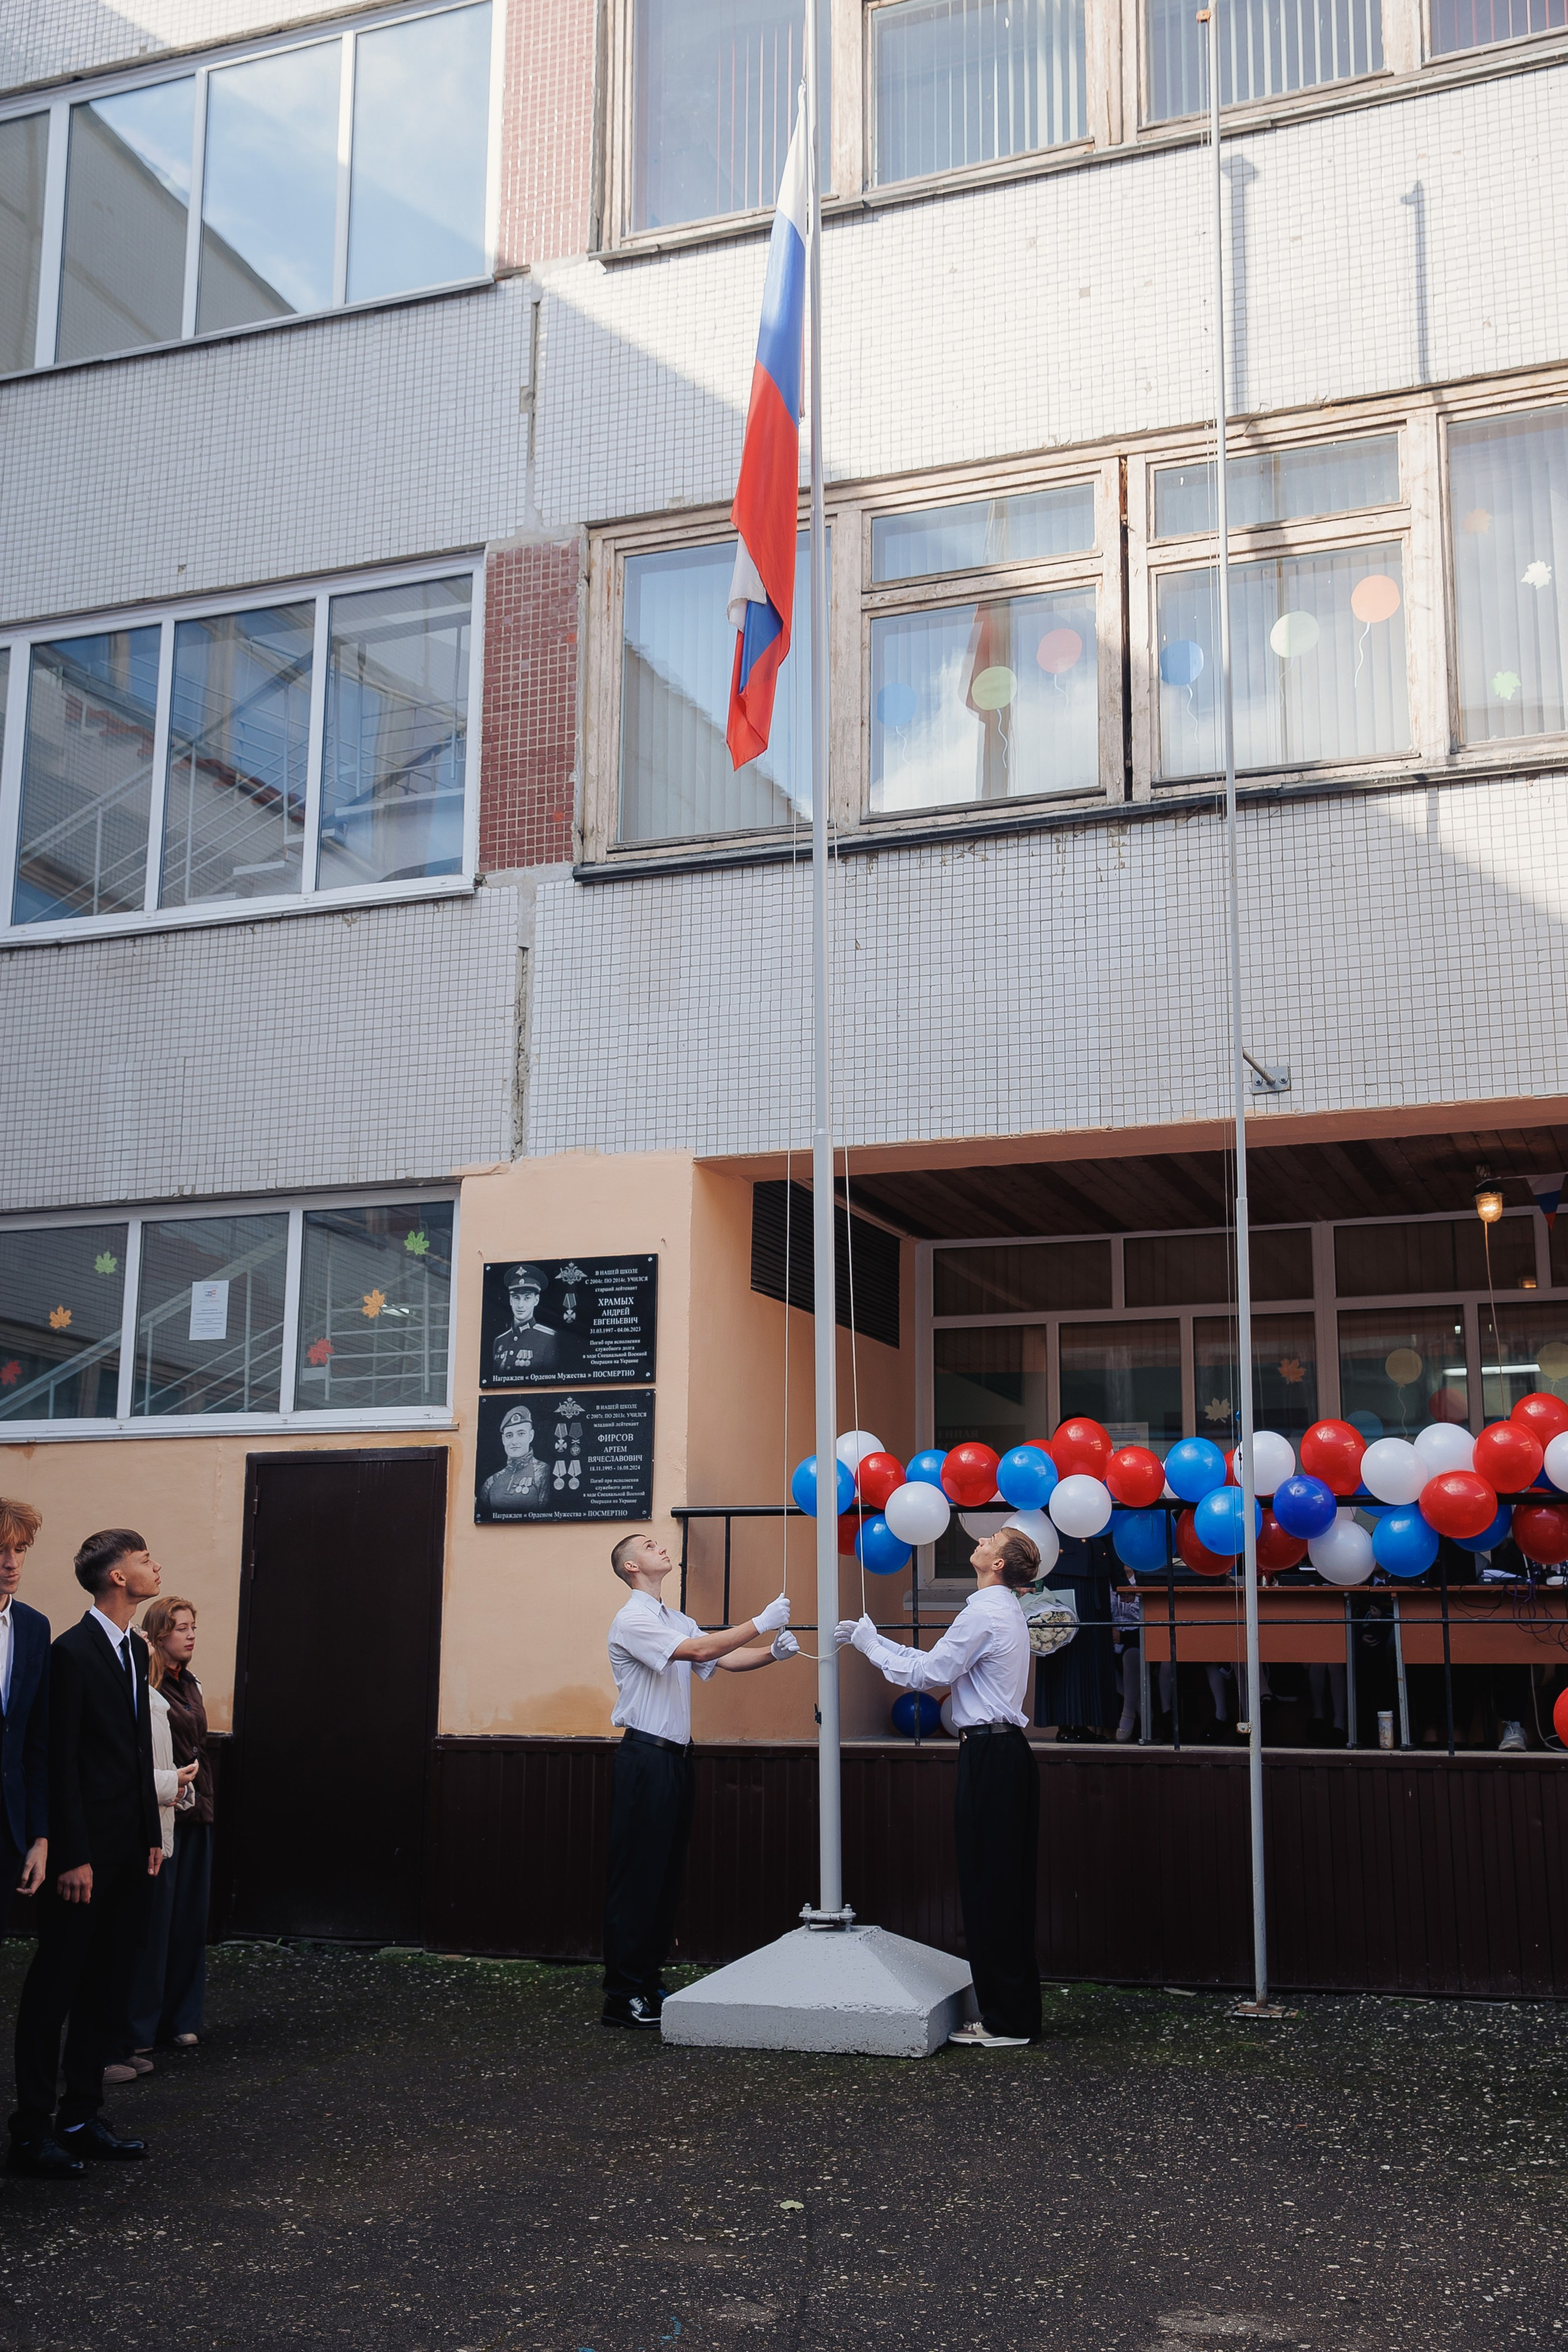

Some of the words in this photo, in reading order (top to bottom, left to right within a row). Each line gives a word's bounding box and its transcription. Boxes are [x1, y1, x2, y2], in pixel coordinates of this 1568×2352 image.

[598, 1297, 634, 1306] ХРАМЫХ
[602, 1307, 630, 1316] АНДРЕЙ
[593, 1317, 638, 1325] ЕВГЕНЬЕВИЧ
[598, 1433, 634, 1442] ФИРСОВ
